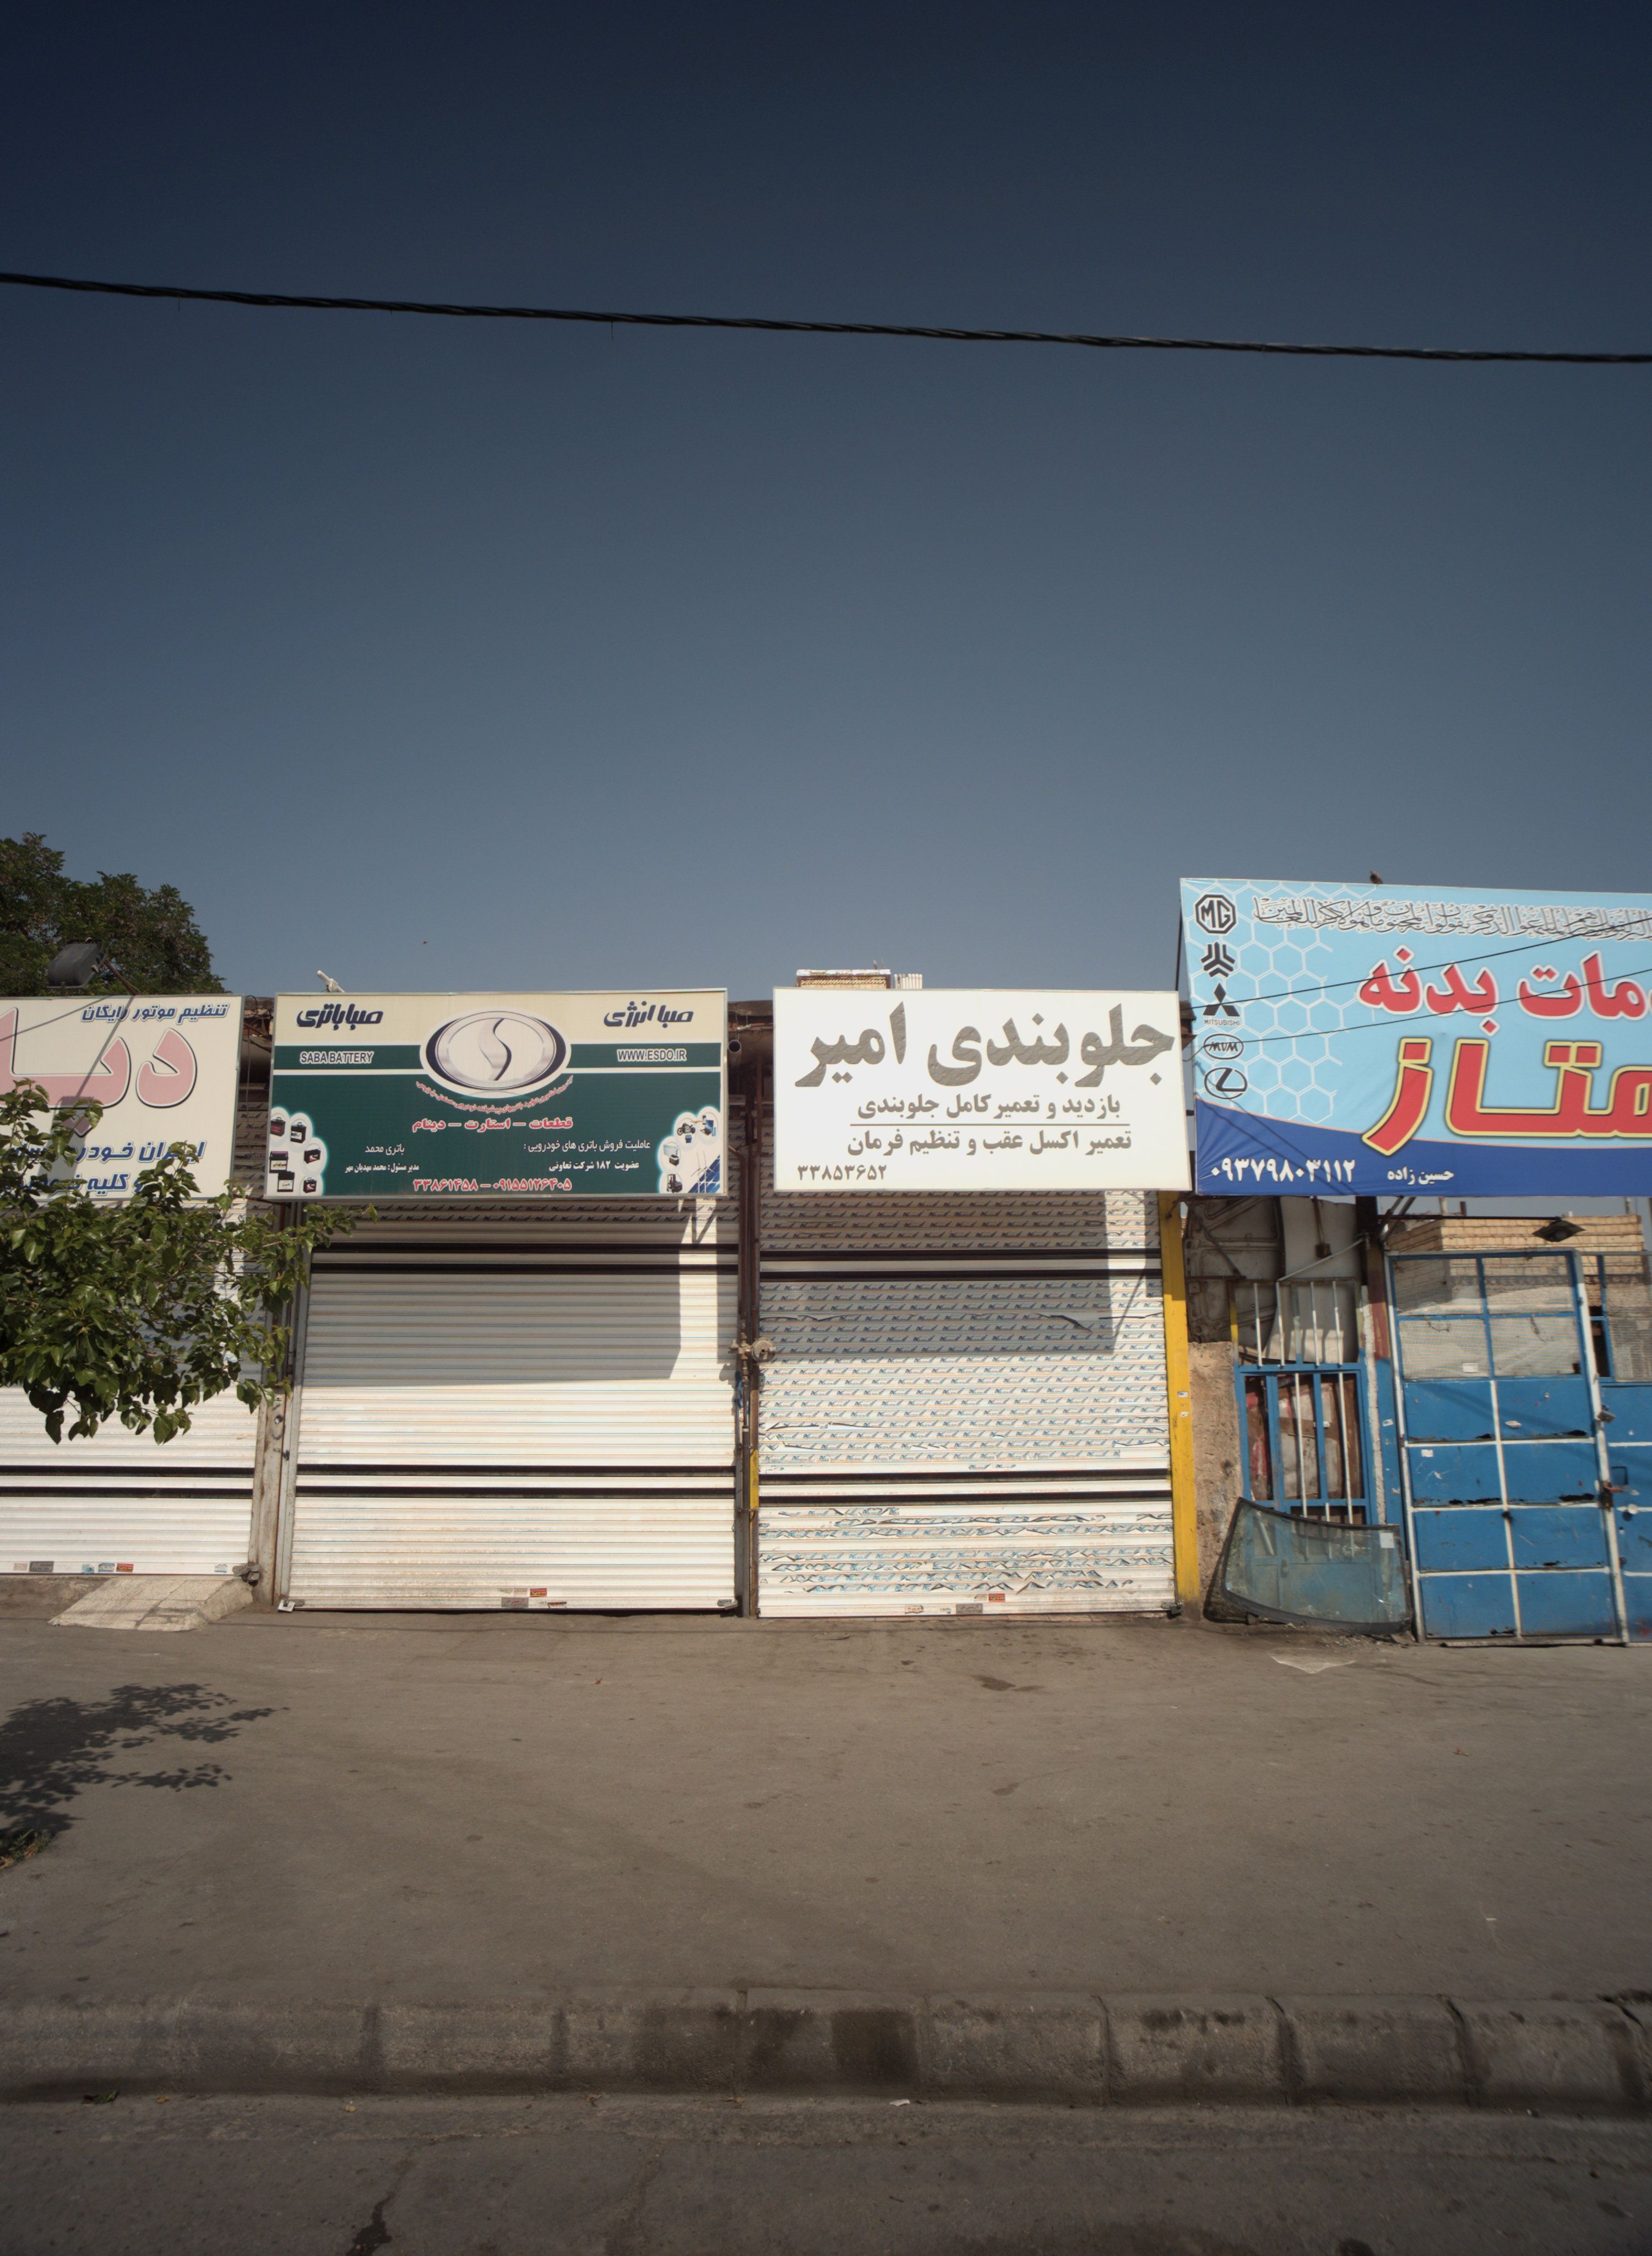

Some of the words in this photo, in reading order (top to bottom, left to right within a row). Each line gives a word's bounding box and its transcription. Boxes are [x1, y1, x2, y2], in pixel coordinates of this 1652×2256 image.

[1200, 899, 1231, 929] MG
[1357, 946, 1498, 1034] بدنه
[1519, 950, 1652, 1019] مات
[81, 1004, 129, 1023] رایگان
[132, 1004, 177, 1022] موتور
[177, 1003, 230, 1025] تنظیم
[296, 1004, 345, 1031] باتری
[345, 1004, 384, 1031] صبا
[604, 1001, 656, 1027] انرژی
[657, 1005, 694, 1028] صبا
[795, 1001, 906, 1087] امیر
[927, 1003, 1175, 1087] جلوبندی
[300, 1051, 327, 1064] SABA
[329, 1051, 374, 1064] BATTERY
[617, 1049, 687, 1062] WWW.ESDO.IR
[857, 1094, 939, 1119] جلوبندی
[947, 1093, 992, 1119] کامل
[993, 1094, 1040, 1119] تعمیر
[1047, 1103, 1056, 1119] و
[1062, 1094, 1120, 1119] بازدید
[412, 1118, 447, 1133] دینام
[464, 1118, 511, 1133] استارت
[529, 1116, 573, 1130] قطعات
[64, 1141, 135, 1164] خودر
[385, 1143, 405, 1156] باتری
[562, 1140, 577, 1152] های
[578, 1140, 597, 1152] باتری
[599, 1139, 623, 1152] فروش
[625, 1139, 650, 1152] عاملیت
[847, 1128, 904, 1156] فرمان
[910, 1130, 960, 1156] تنظیم
[966, 1138, 977, 1156] و
[983, 1131, 1023, 1154] عقب
[1030, 1130, 1079, 1155] اکسل
[1085, 1131, 1132, 1156] تعمیر
[548, 1161, 572, 1172] تعاونی
[573, 1161, 595, 1172] شرکت
[596, 1160, 611, 1169] ۱۸۲
[614, 1162, 639, 1171] عضویت
[797, 1164, 887, 1181] ۳۳۸۵۳۶۵۲
[1211, 1158, 1355, 1182] ۰۹۳۷۹۸۰۳۱۱۲
[86, 1173, 130, 1197] کلیه
[1387, 1167, 1415, 1185] زاده
[1418, 1170, 1454, 1185] حسین
